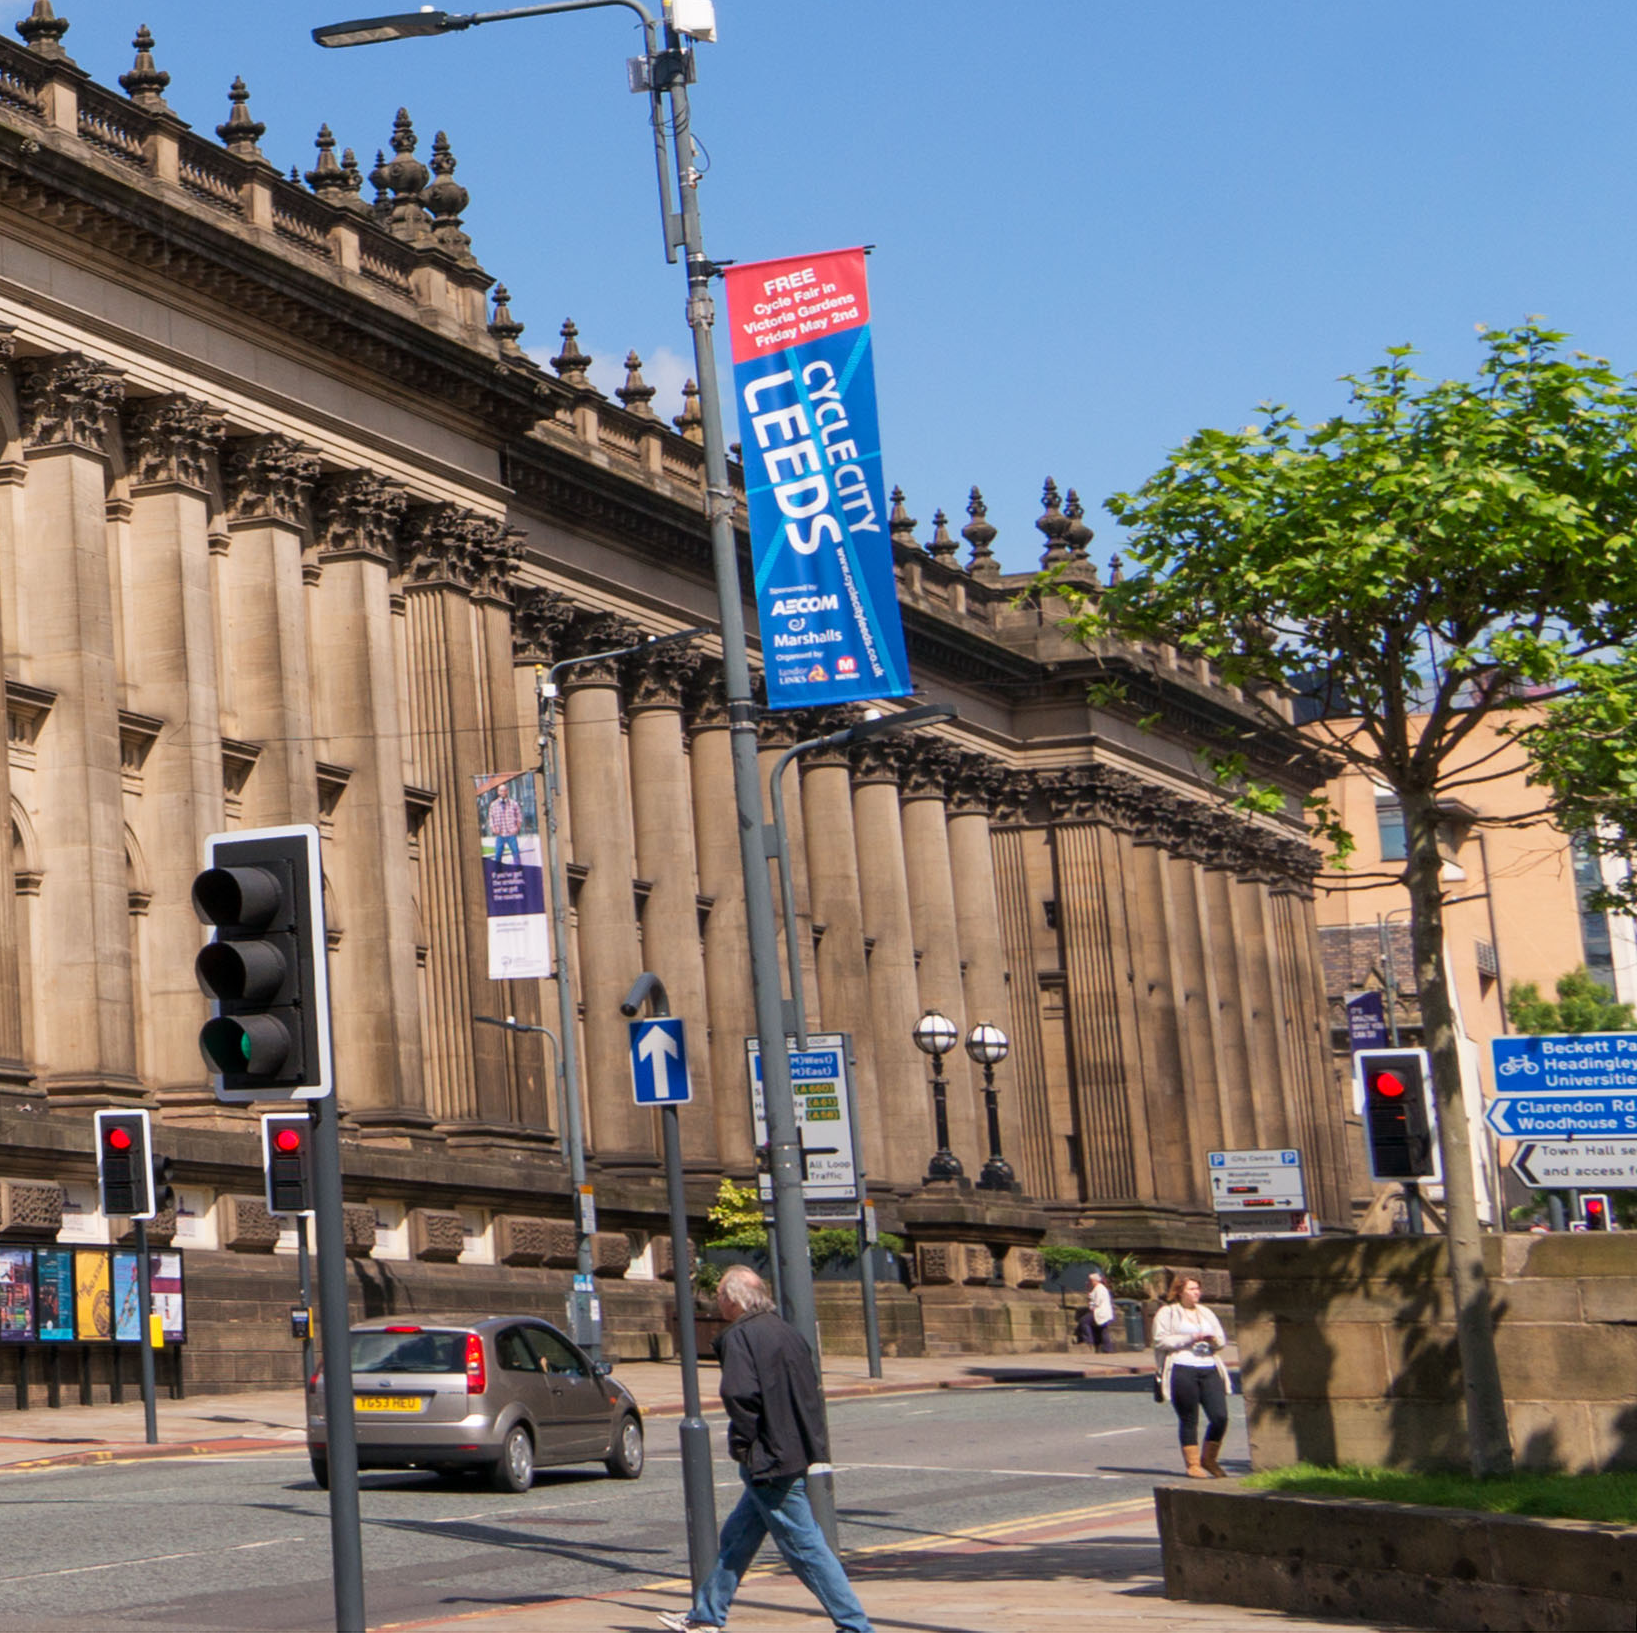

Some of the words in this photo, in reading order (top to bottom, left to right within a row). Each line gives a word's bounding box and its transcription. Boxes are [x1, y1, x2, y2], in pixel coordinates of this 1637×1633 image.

[763, 267, 817, 296] FREE
[753, 295, 792, 316] Cycle
[793, 288, 820, 304] Fair
[822, 282, 836, 294] in
[743, 311, 796, 334] Victoria
[797, 294, 855, 318] Gardens
[755, 326, 798, 348] Friday
[799, 317, 829, 336] May
[831, 307, 859, 324] 2nd
[743, 369, 842, 555] LEEDS
[770, 594, 839, 617] AECOM
[836, 546, 885, 678] www.cyclecityleeds.co.uk
[774, 628, 843, 648] Marshalls
[1542, 1041, 1609, 1054] Beckett
[1517, 1101, 1604, 1114] Clarendon
[1517, 1117, 1618, 1130] Woodhouse
[1541, 1145, 1579, 1156] Town
[1586, 1145, 1615, 1156] Hall
[809, 1160, 823, 1169] All
[827, 1160, 851, 1170] Loop
[1543, 1166, 1569, 1177] and
[1575, 1167, 1624, 1177] access
[809, 1172, 843, 1180] Traffic
